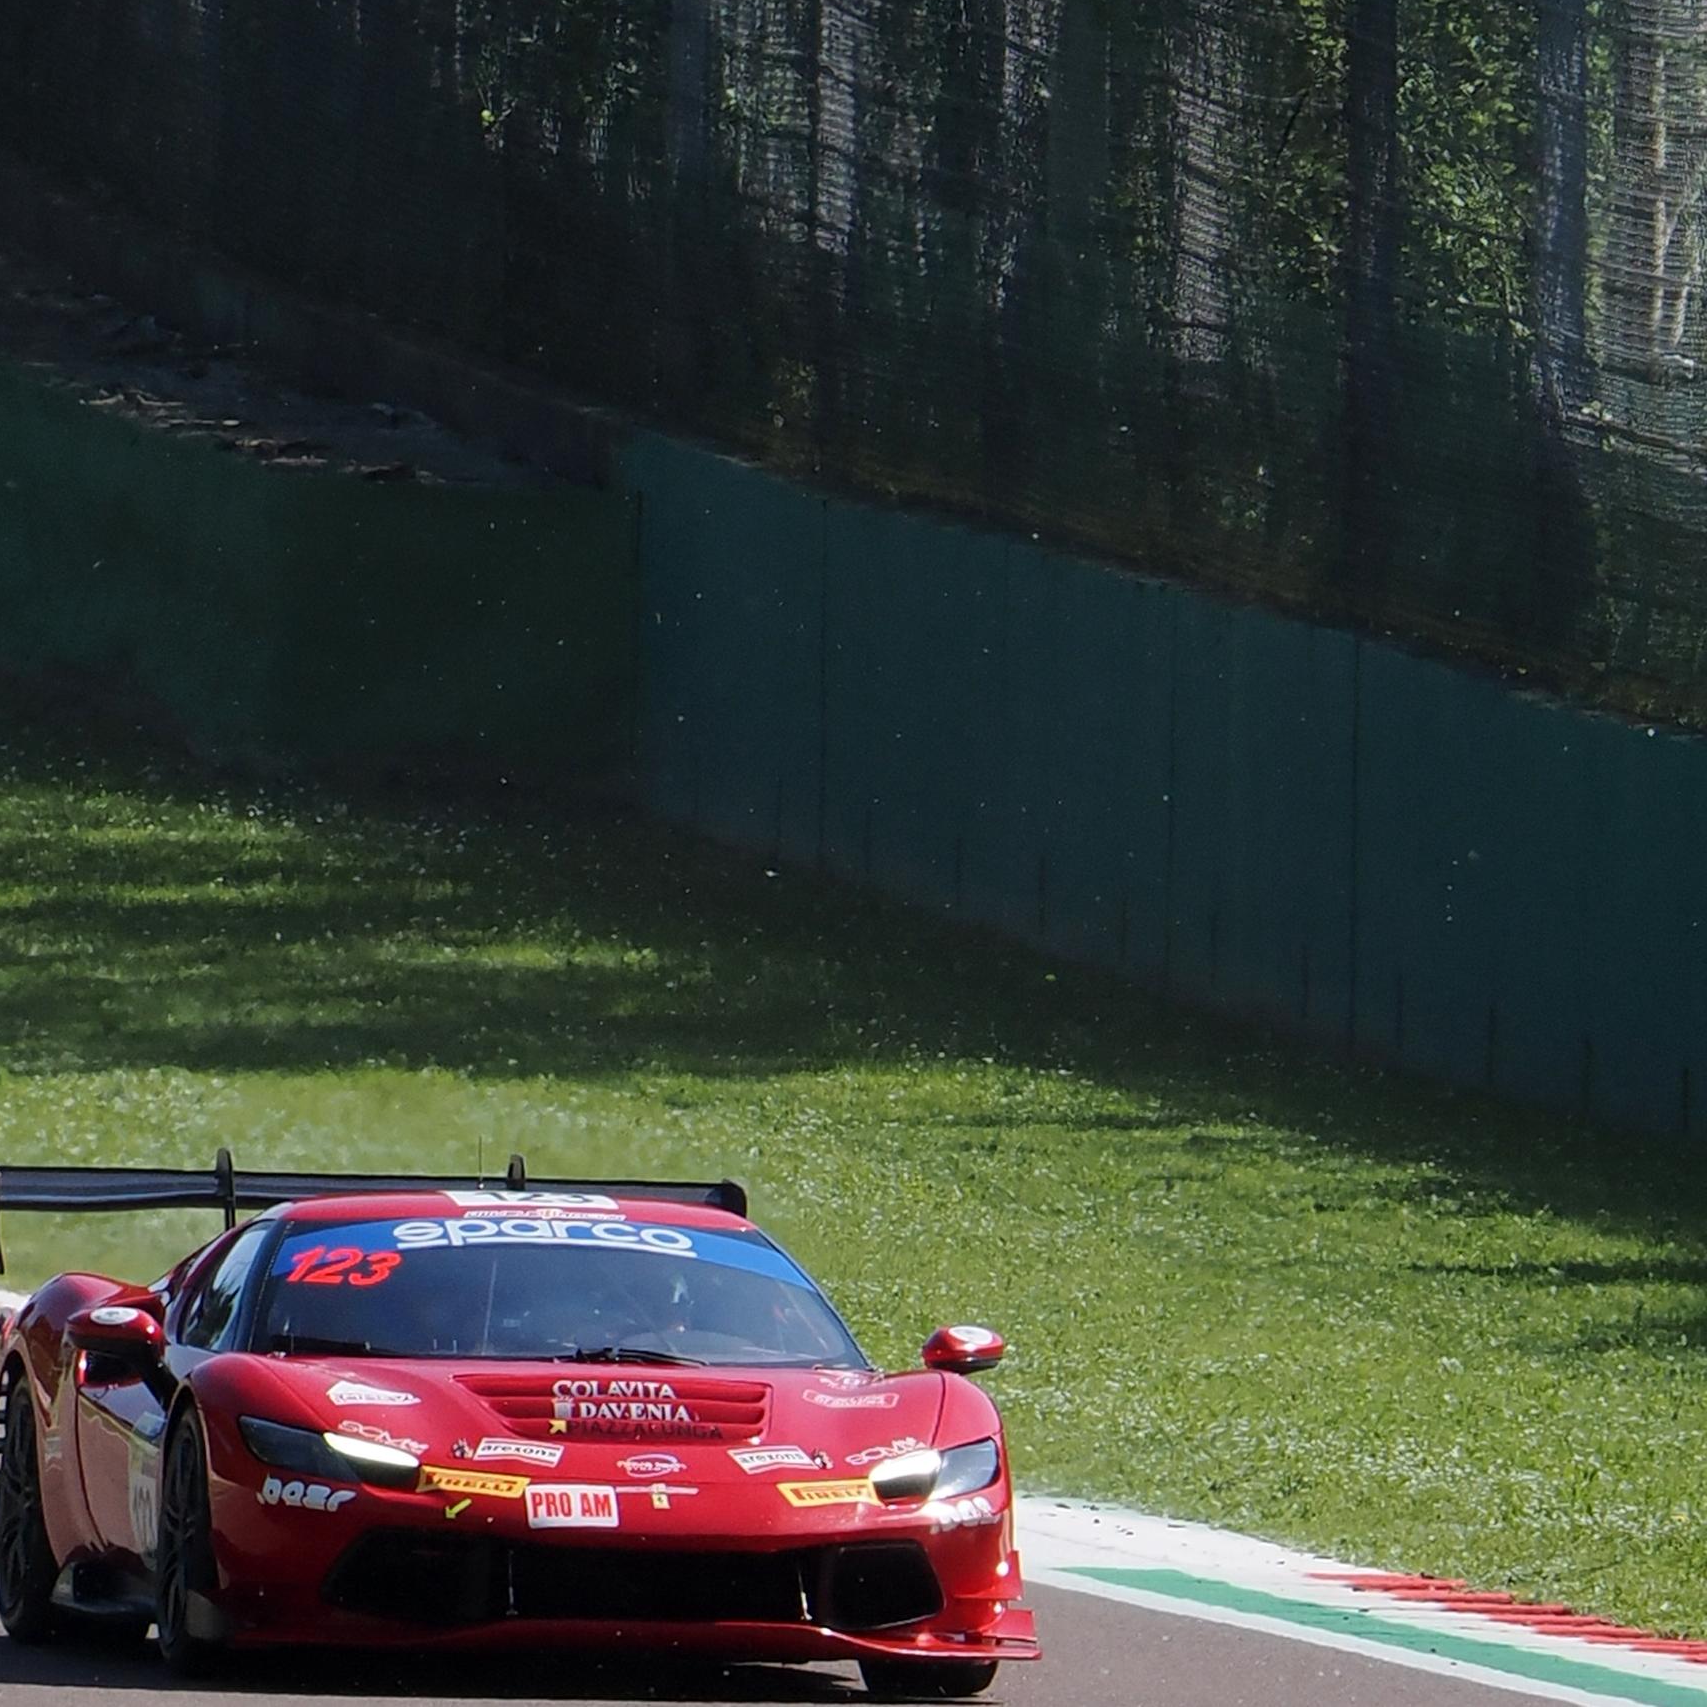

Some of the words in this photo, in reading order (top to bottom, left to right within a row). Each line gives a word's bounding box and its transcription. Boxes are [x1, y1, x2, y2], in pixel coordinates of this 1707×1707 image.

[393, 1215, 696, 1257] sparco
[285, 1244, 403, 1287] 123
[552, 1379, 677, 1400] COLAVITA
[480, 1442, 559, 1460] arexons
[424, 1471, 520, 1494] PIRELLI
[530, 1491, 573, 1520] PRO
[580, 1492, 613, 1519] AM
